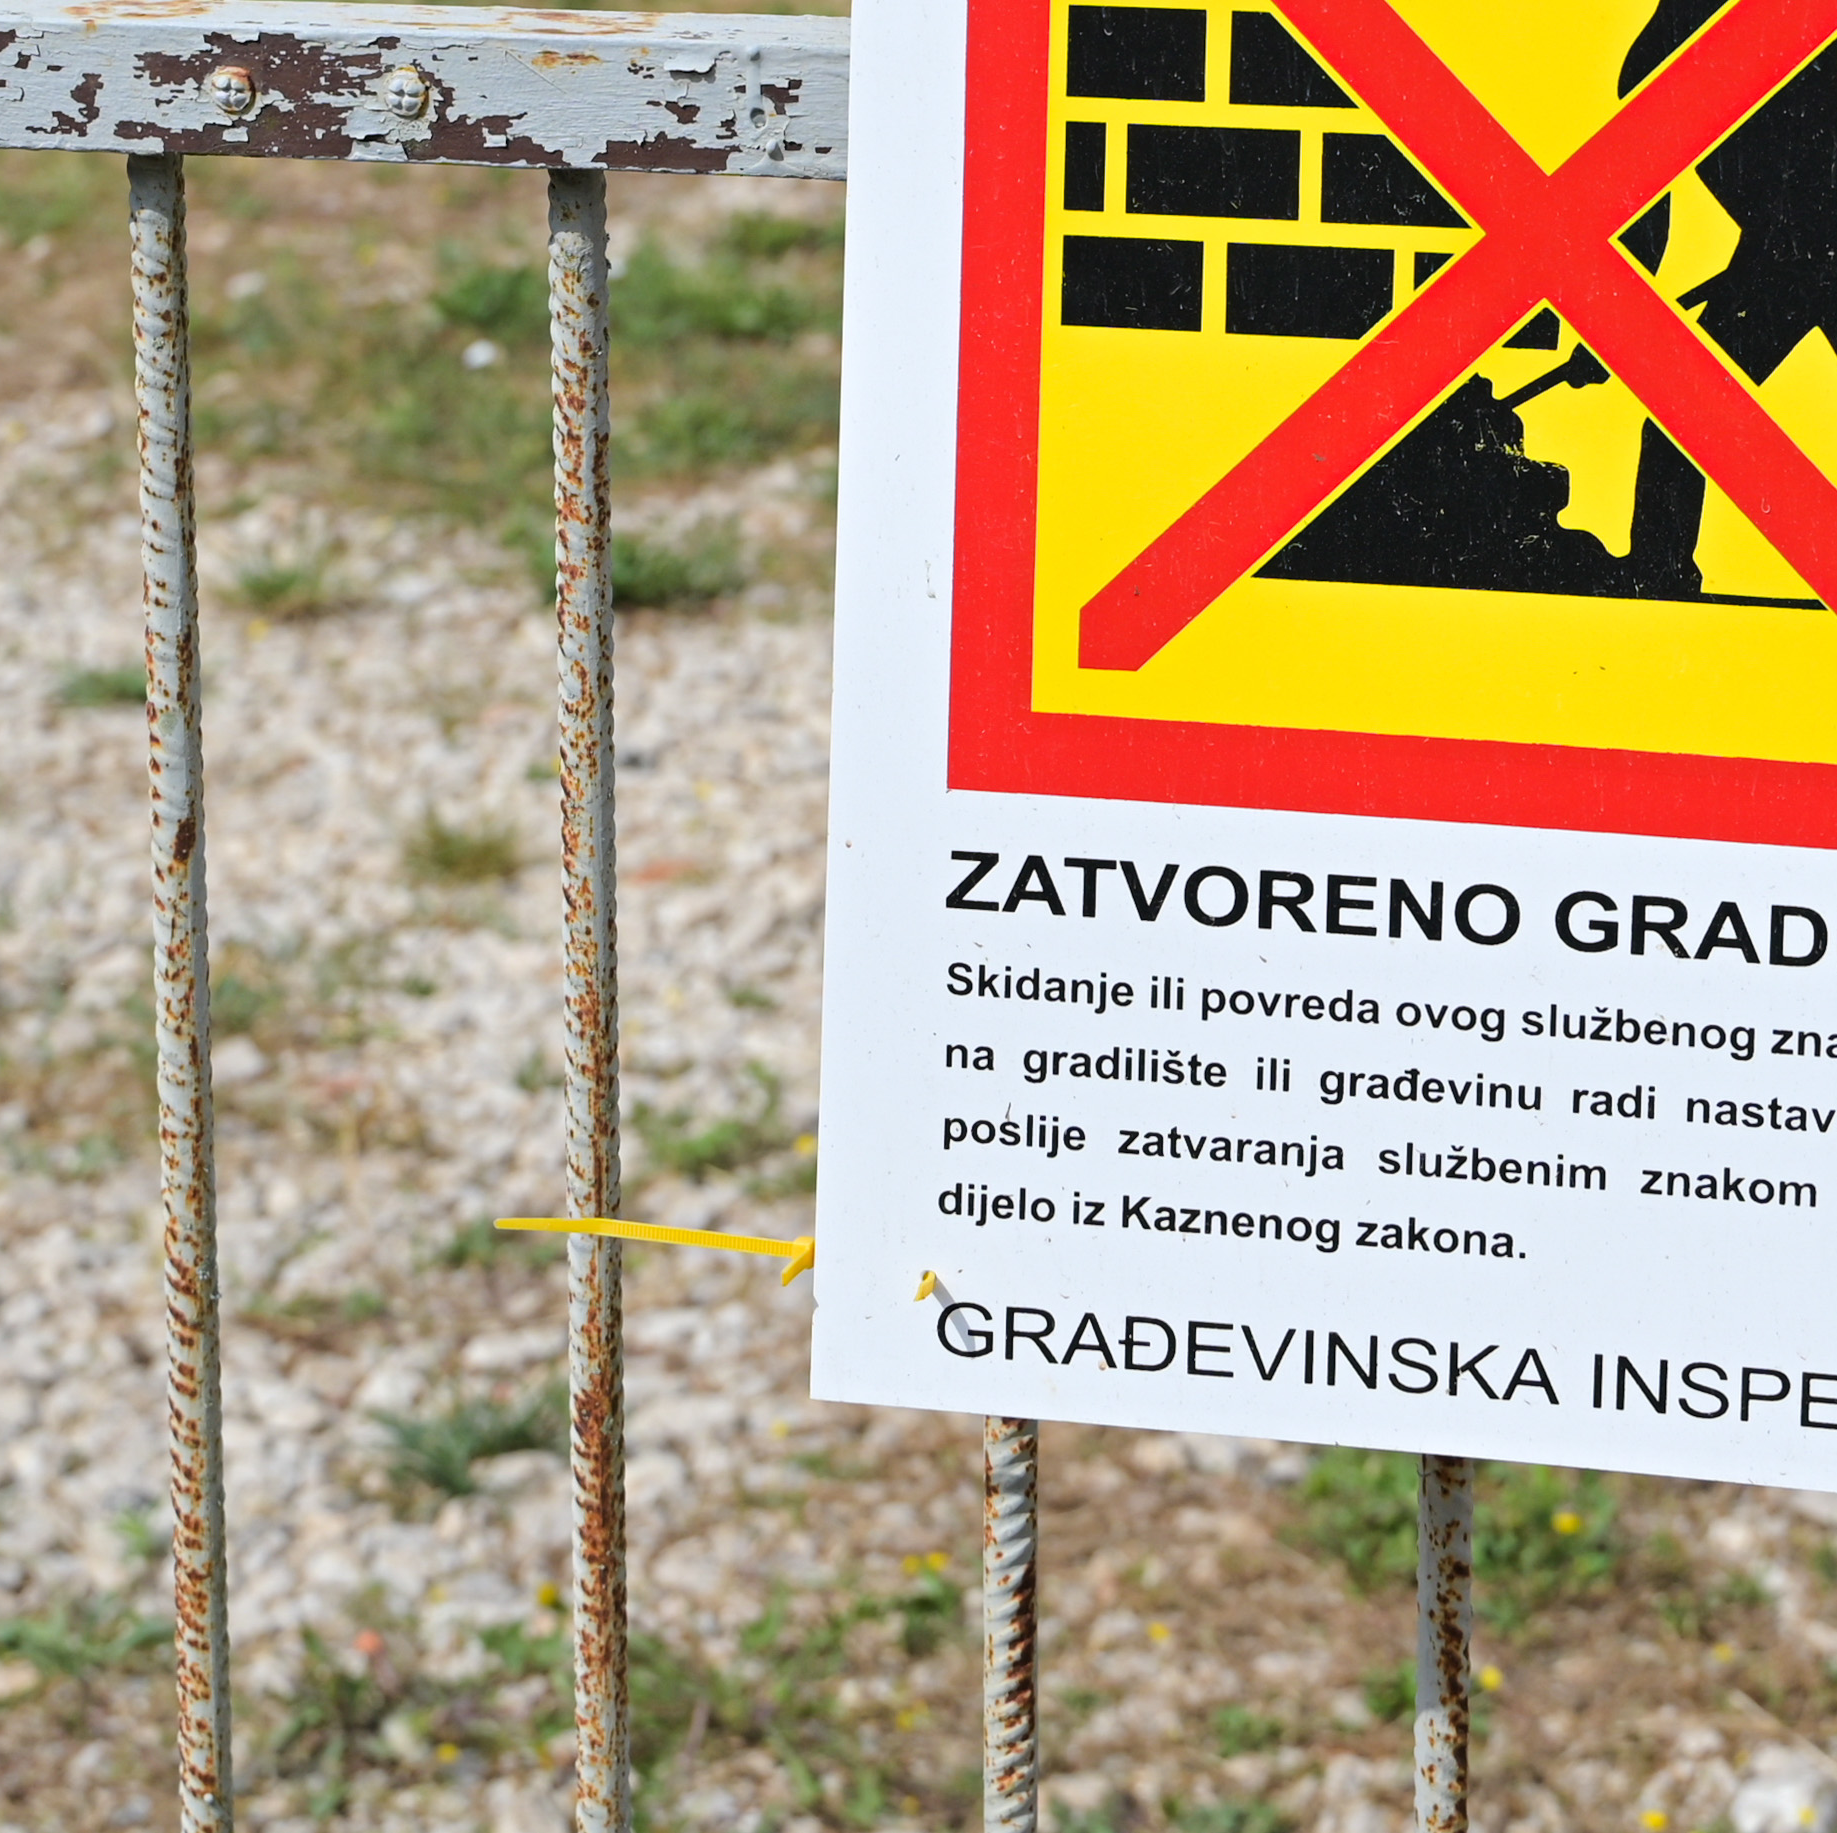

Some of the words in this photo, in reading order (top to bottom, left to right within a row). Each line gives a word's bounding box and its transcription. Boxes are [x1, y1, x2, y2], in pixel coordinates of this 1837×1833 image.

[945, 850, 1521, 946] ZATVORENO
[946, 962, 1134, 1015] Skidanje
[1150, 975, 1184, 1011] ili
[1201, 988, 1380, 1025] povreda
[1395, 1002, 1505, 1043] ovog
[1521, 1003, 1756, 1062] službenog
[945, 1044, 995, 1071] na
[1023, 1046, 1227, 1088] gradilište
[1256, 1056, 1291, 1093] ili
[1319, 1068, 1542, 1111] građevinu
[1572, 1084, 1656, 1120] radi
[942, 1113, 1087, 1159] poslije
[1117, 1126, 1344, 1178] zatvaranja
[1378, 1142, 1607, 1191] službenim
[1640, 1167, 1817, 1208] znakom
[938, 1182, 1056, 1227] dijelo
[1072, 1191, 1105, 1227] iz
[1121, 1195, 1341, 1254] Kaznenog
[1355, 1216, 1526, 1259] zakona.
[936, 1301, 1560, 1406] GRAĐEVINSKA
